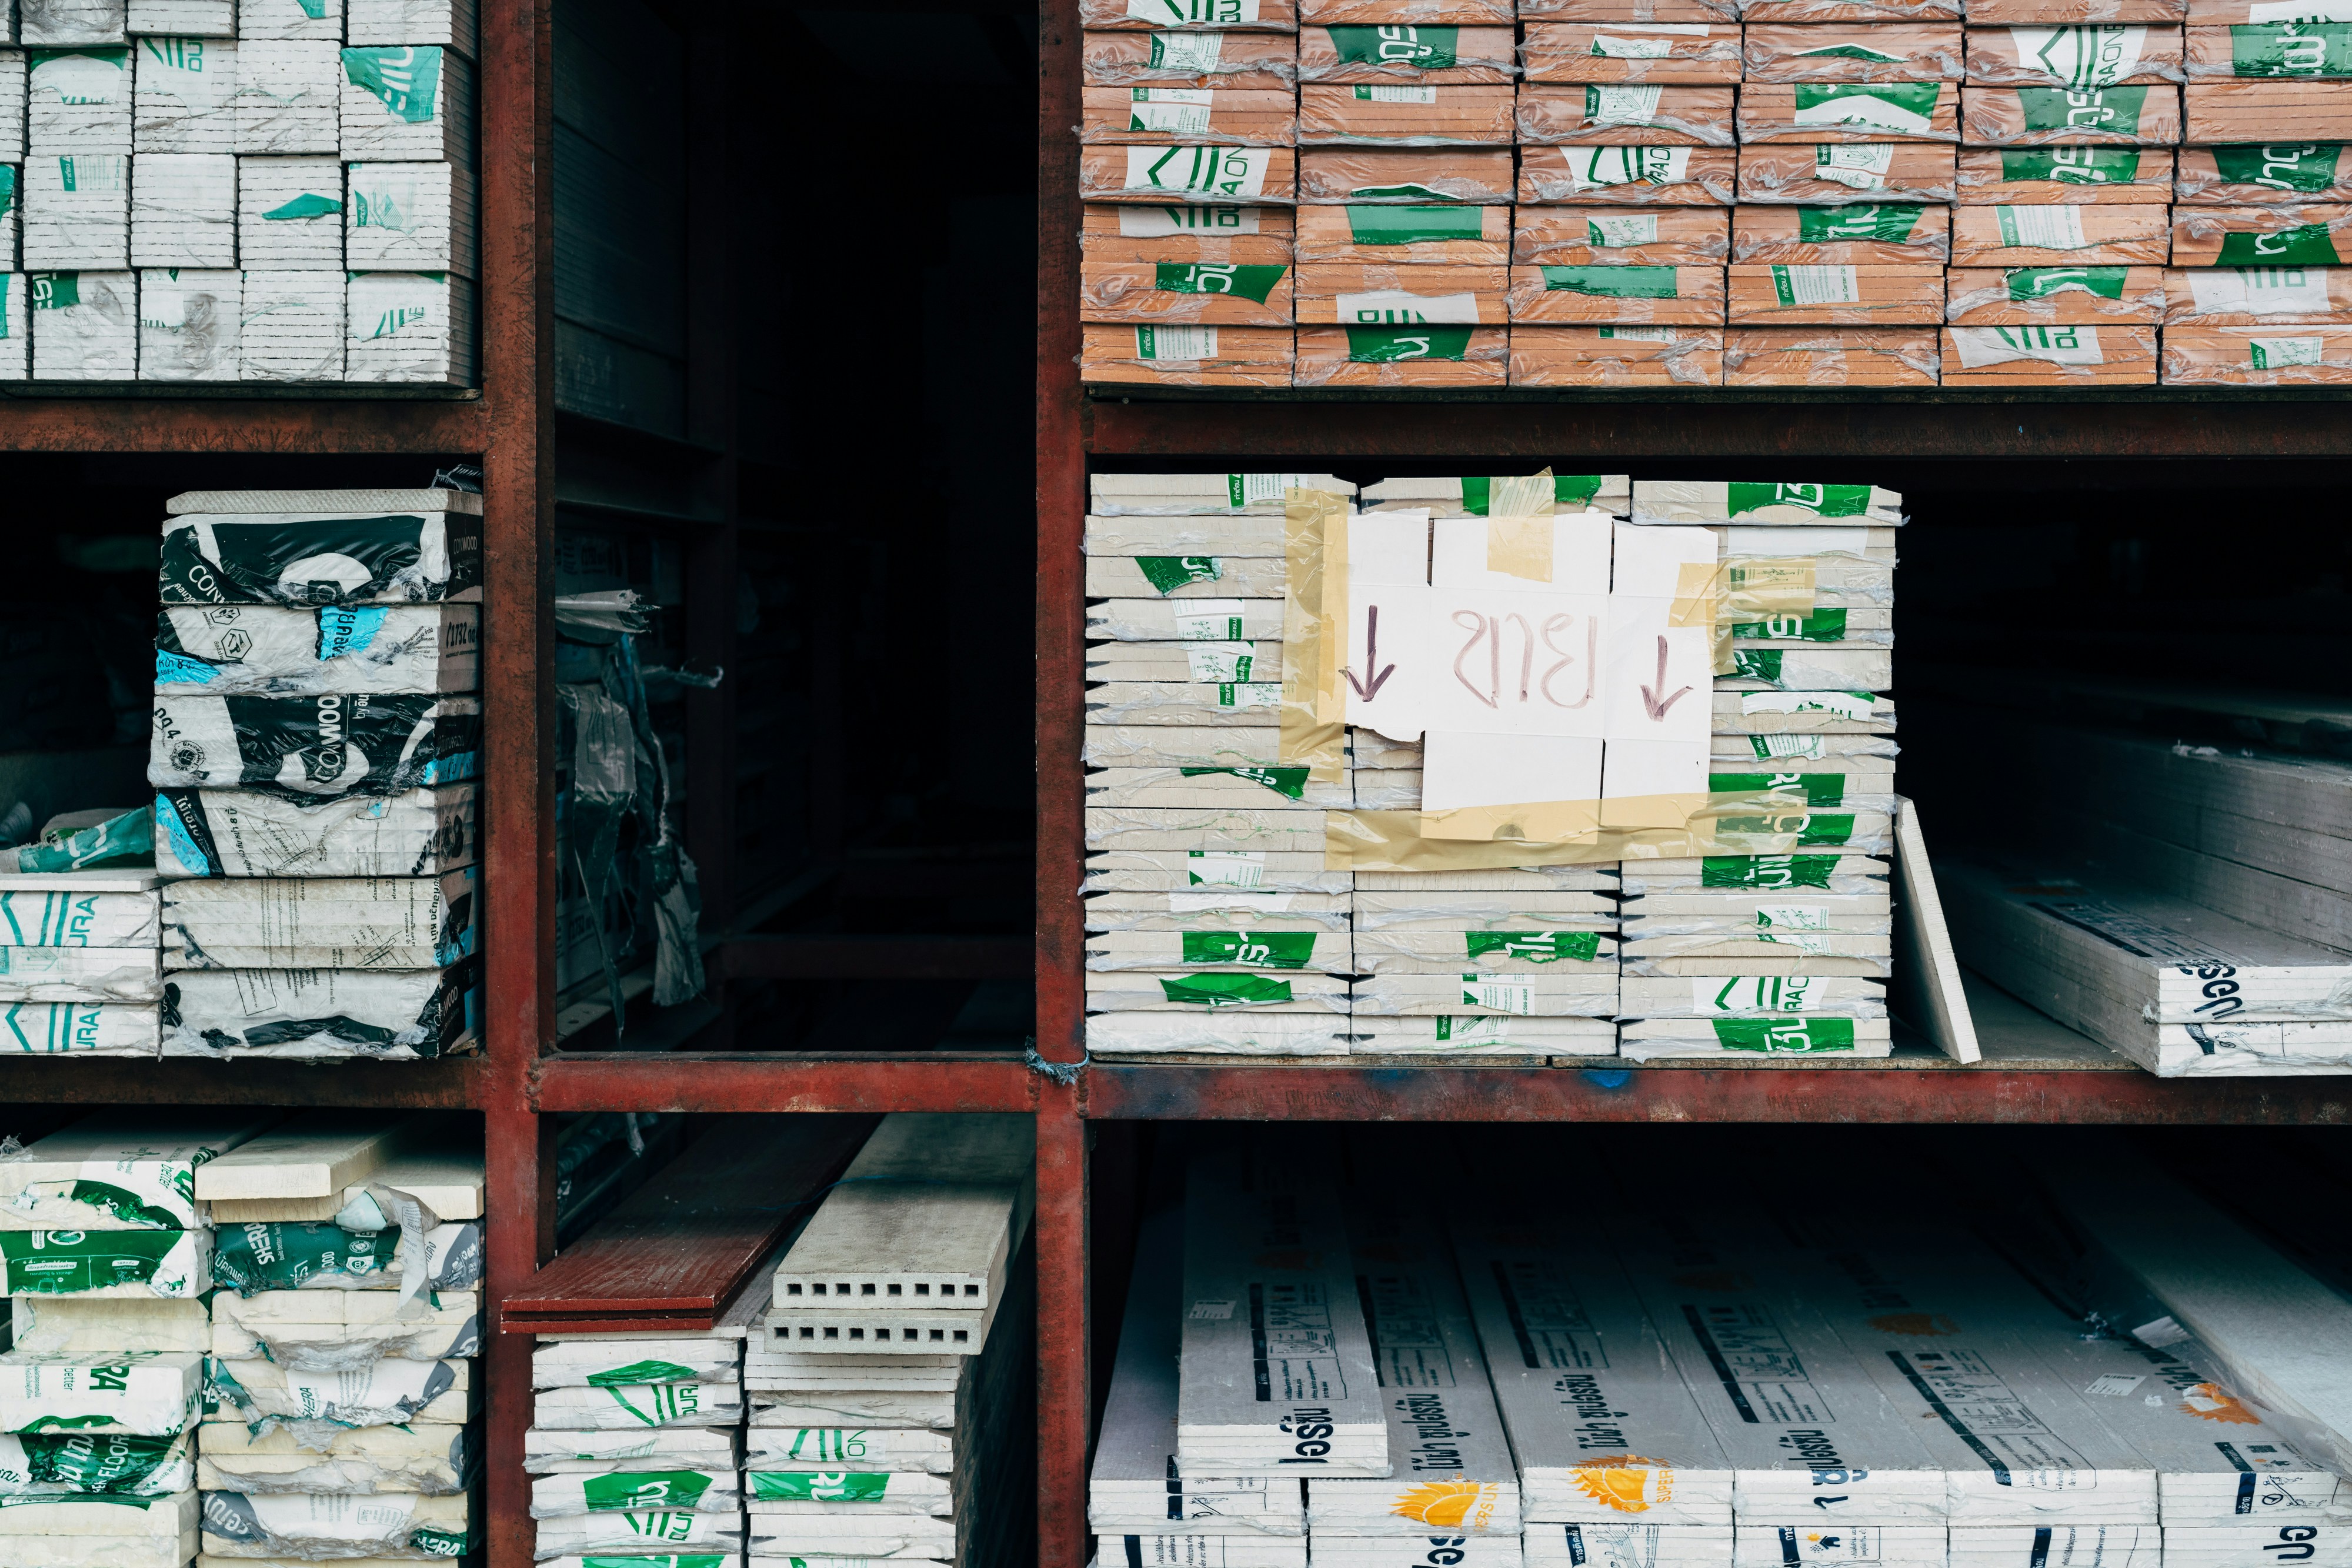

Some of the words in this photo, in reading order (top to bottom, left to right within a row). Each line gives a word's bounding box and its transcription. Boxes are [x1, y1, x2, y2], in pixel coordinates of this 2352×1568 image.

[189, 565, 224, 602] CON
[451, 622, 468, 646] 1732
[1450, 609, 1598, 710] ขาย
[159, 1163, 174, 1189] better
[406, 1222, 422, 1232] PAINT
[243, 1223, 275, 1265] SHERA
[64, 1367, 74, 1391] better
[1656, 1470, 1674, 1503] SUPER
[1574, 1530, 1584, 1562] การติดตั้ง
